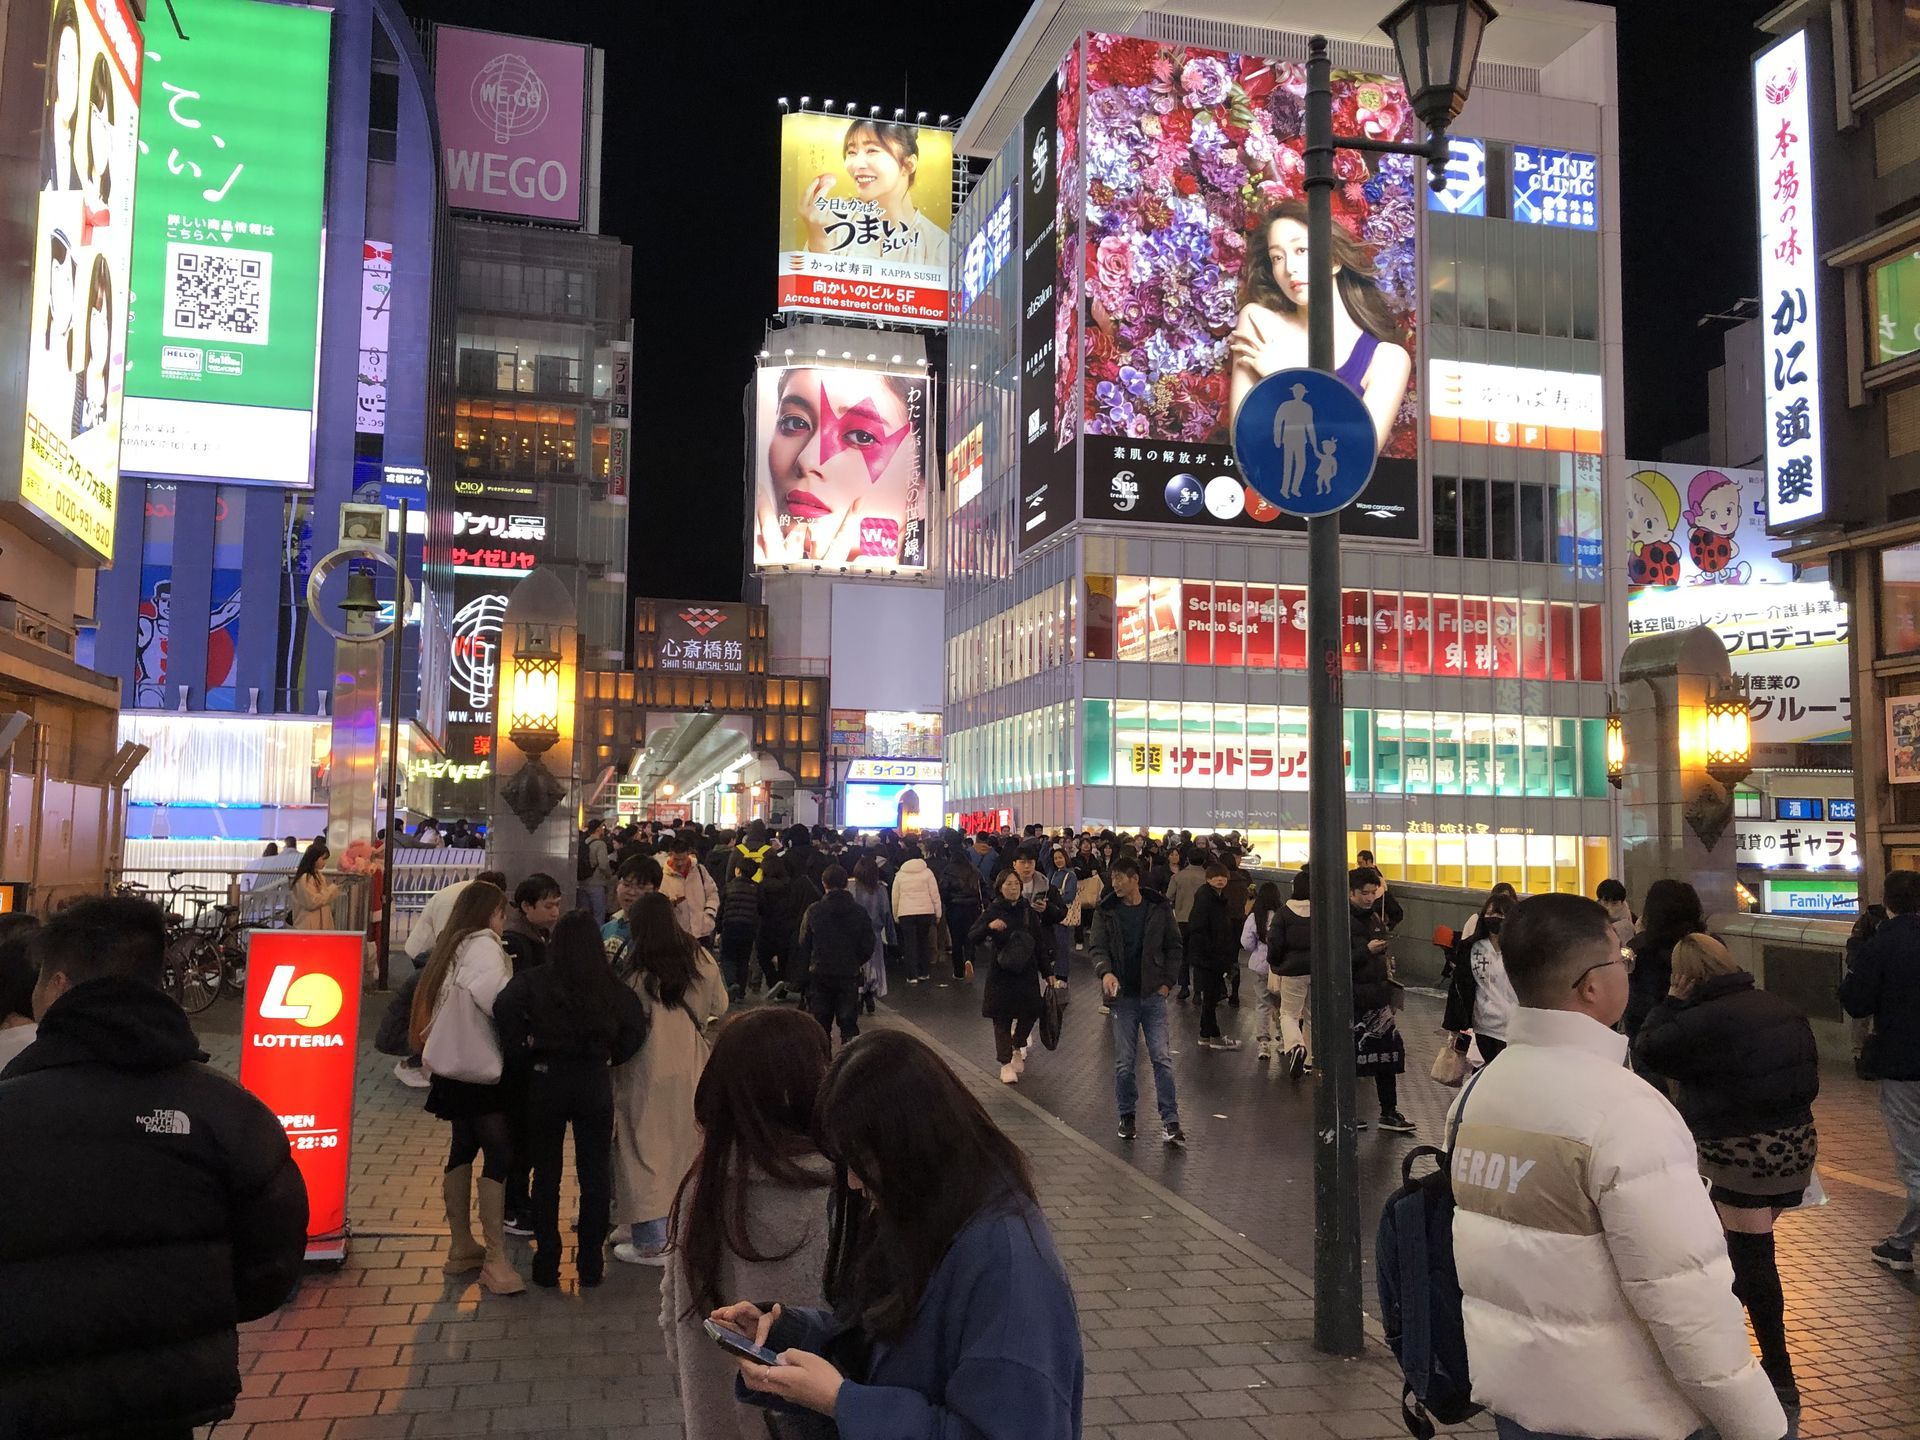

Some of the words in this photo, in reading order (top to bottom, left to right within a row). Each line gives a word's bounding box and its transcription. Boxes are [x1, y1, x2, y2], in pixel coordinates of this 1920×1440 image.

[446, 148, 567, 201] WEGO
[1514, 152, 1595, 180] B-LINE
[1529, 174, 1594, 196] CLINIC
[1770, 118, 1802, 265] 本場の味
[167, 213, 275, 236] 詳しい商品情報は
[824, 211, 908, 251] うまい
[811, 259, 872, 277] かっぱ寿司
[881, 267, 911, 279] KAPPA
[914, 271, 941, 282] SUSHI
[784, 293, 820, 304] Across
[823, 296, 838, 307] the
[840, 298, 870, 310] street
[873, 301, 883, 311] of
[885, 302, 900, 313] the
[902, 304, 918, 315] 5th
[919, 306, 943, 318] floor
[1111, 477, 1138, 495] Spa
[56, 491, 109, 548] 0120-951-820
[453, 548, 535, 569] サイゼリヤ
[1188, 597, 1241, 614] Scenic
[1246, 599, 1288, 616] Place
[1188, 619, 1226, 634] Photo
[1228, 621, 1259, 635] Spot
[1391, 609, 1429, 629] Tax
[1438, 613, 1489, 634] Free
[1496, 616, 1546, 641] Shop
[661, 638, 743, 660] 心斎橋筋
[1445, 642, 1499, 670] 免税
[1135, 746, 1160, 772] 薬
[873, 765, 916, 776] タイコク
[1789, 801, 1801, 816] 酒
[253, 1034, 344, 1047] LOTTERIA
[136, 1115, 172, 1126] NORTH
[154, 1109, 174, 1118] THE
[145, 1124, 171, 1133] FACE
[297, 1135, 337, 1149] 22:30
